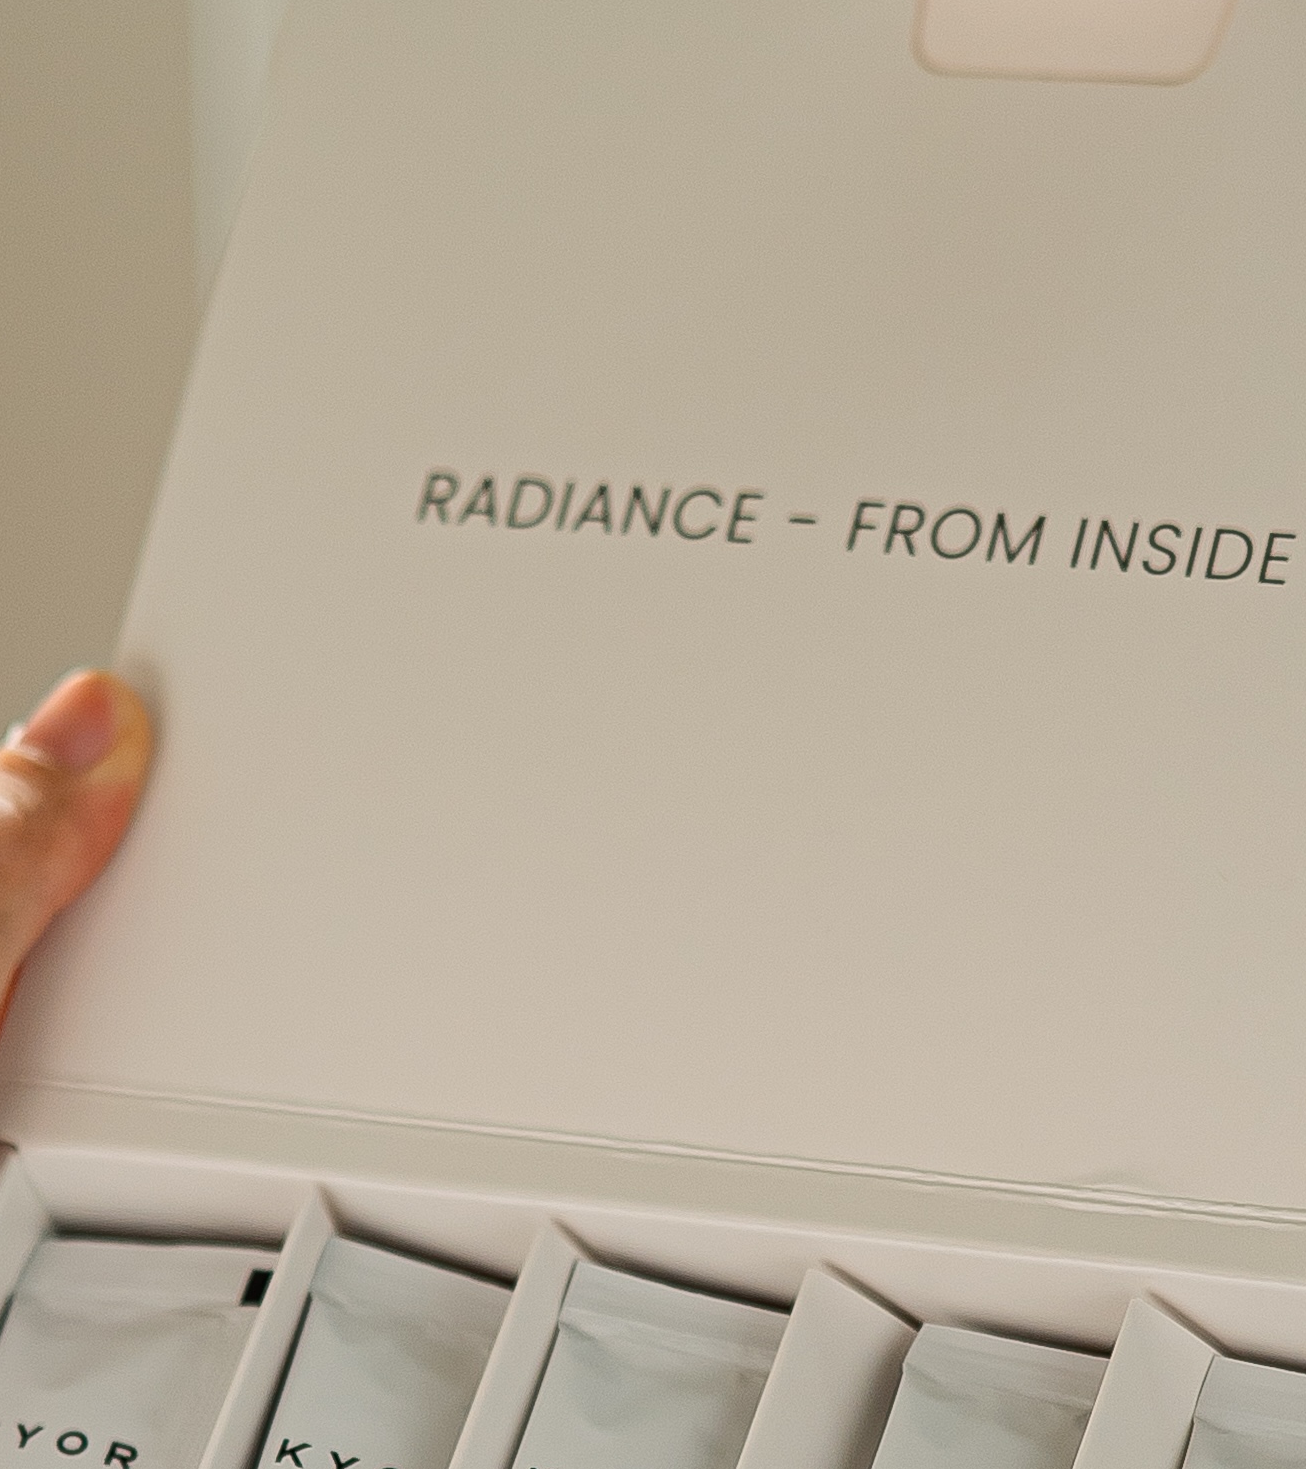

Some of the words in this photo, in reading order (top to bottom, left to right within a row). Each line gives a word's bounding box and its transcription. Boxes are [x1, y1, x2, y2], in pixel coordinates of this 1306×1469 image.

[419, 472, 764, 544] RADIANCE
[846, 502, 1046, 565] FROM
[1071, 519, 1296, 585] INSIDE
